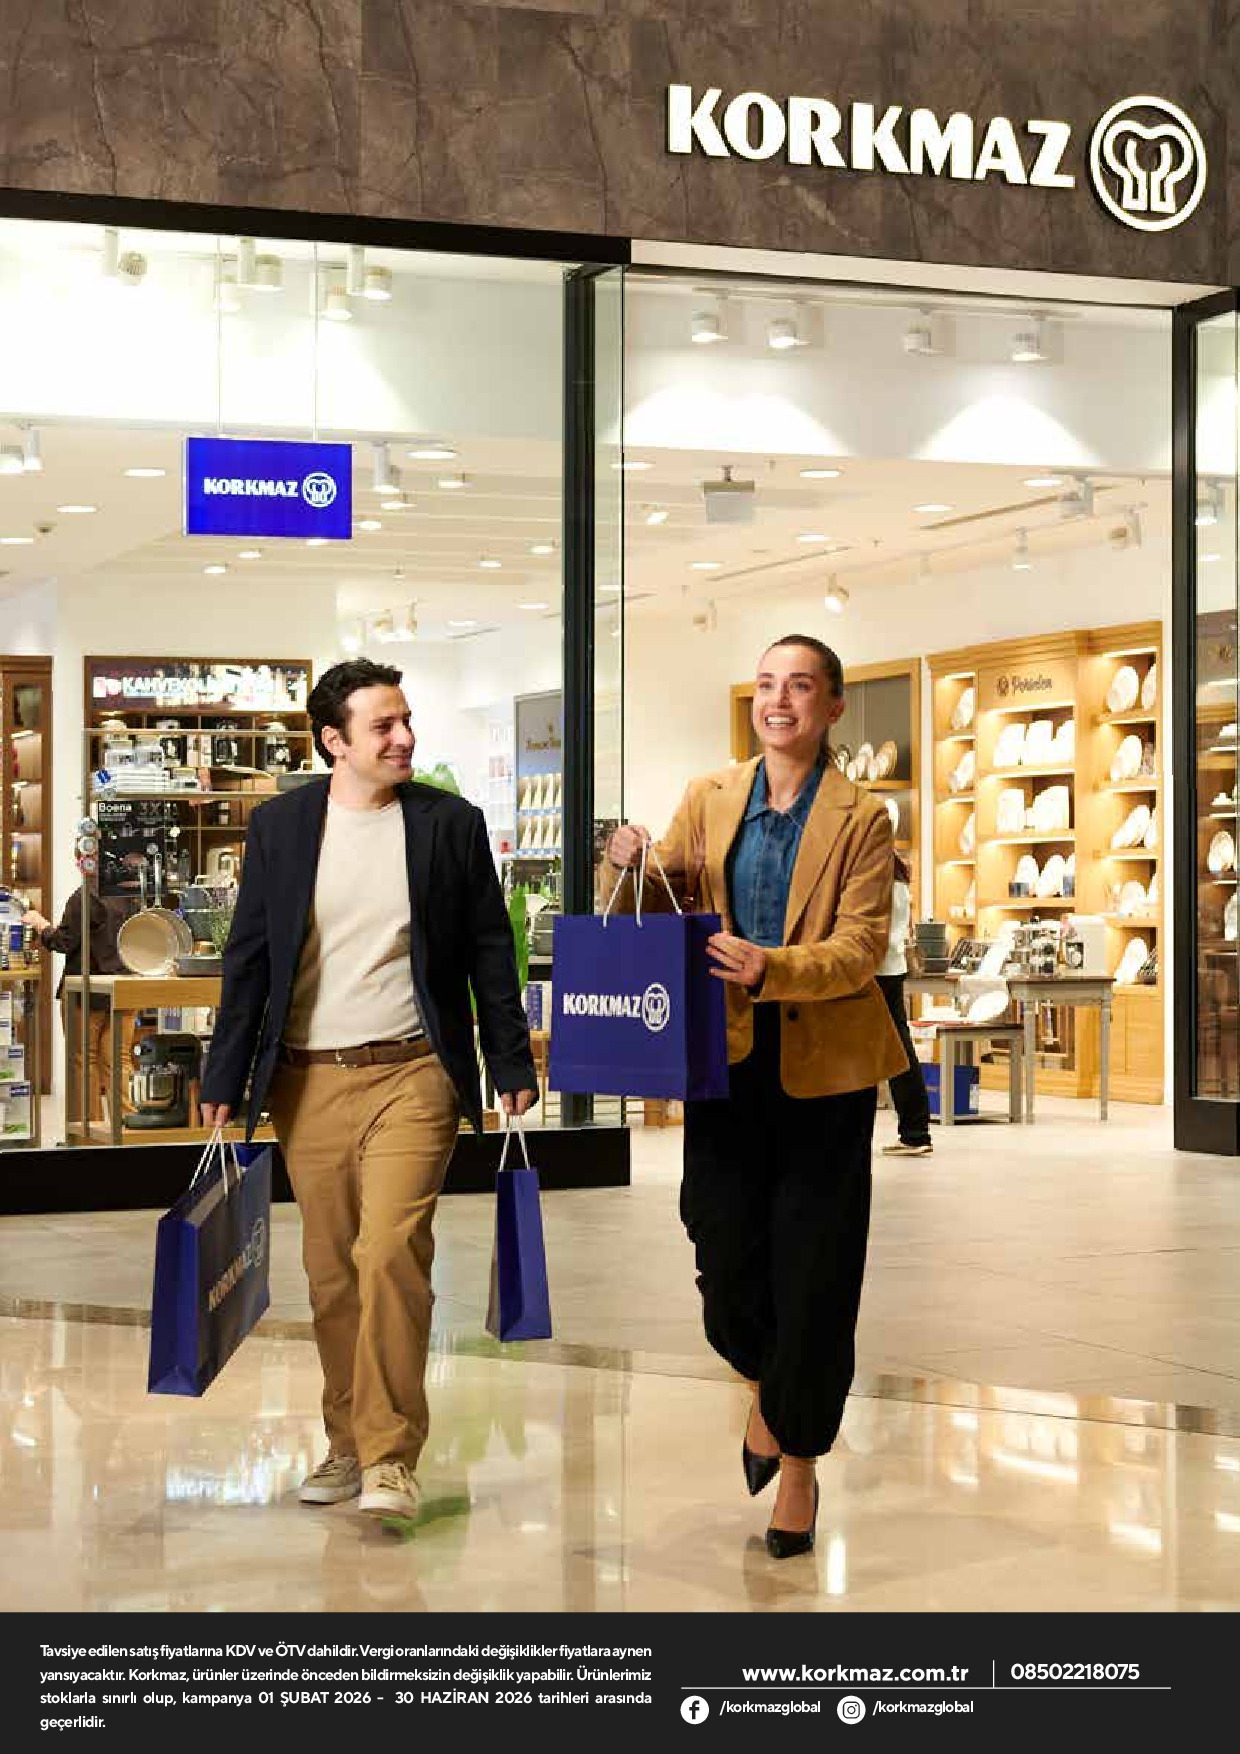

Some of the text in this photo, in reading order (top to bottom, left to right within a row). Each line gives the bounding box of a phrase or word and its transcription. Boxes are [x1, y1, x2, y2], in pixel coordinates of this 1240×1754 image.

[667, 83, 1076, 189] KORKMAZ
[203, 477, 299, 498] KORKMAZ
[562, 992, 642, 1018] KORKMAZ
